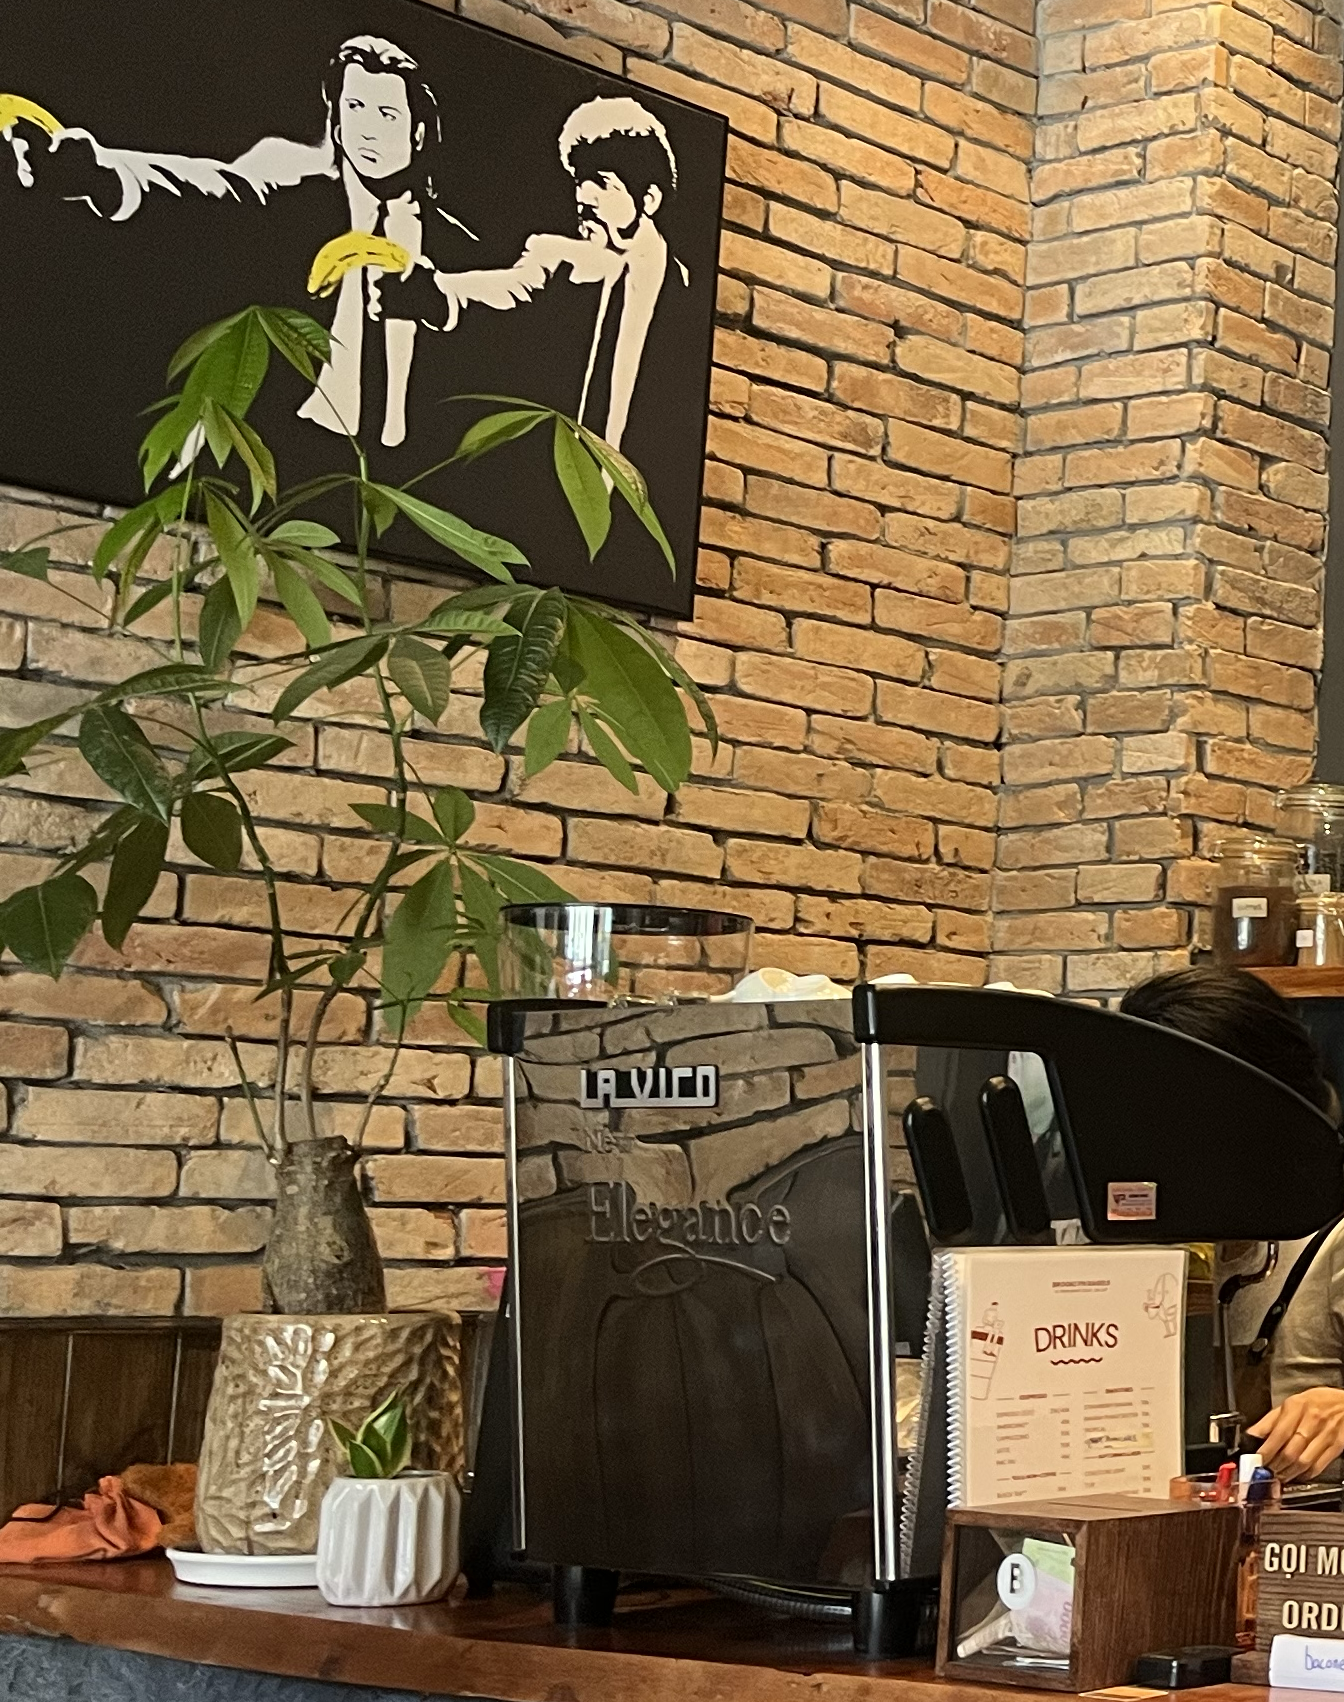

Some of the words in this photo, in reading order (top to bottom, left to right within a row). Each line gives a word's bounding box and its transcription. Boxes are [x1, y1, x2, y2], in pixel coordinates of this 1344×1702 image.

[580, 1068, 616, 1108] LA
[585, 1181, 790, 1248] Elegance
[1034, 1323, 1119, 1353] DRINKS
[1264, 1542, 1307, 1578] GỌI
